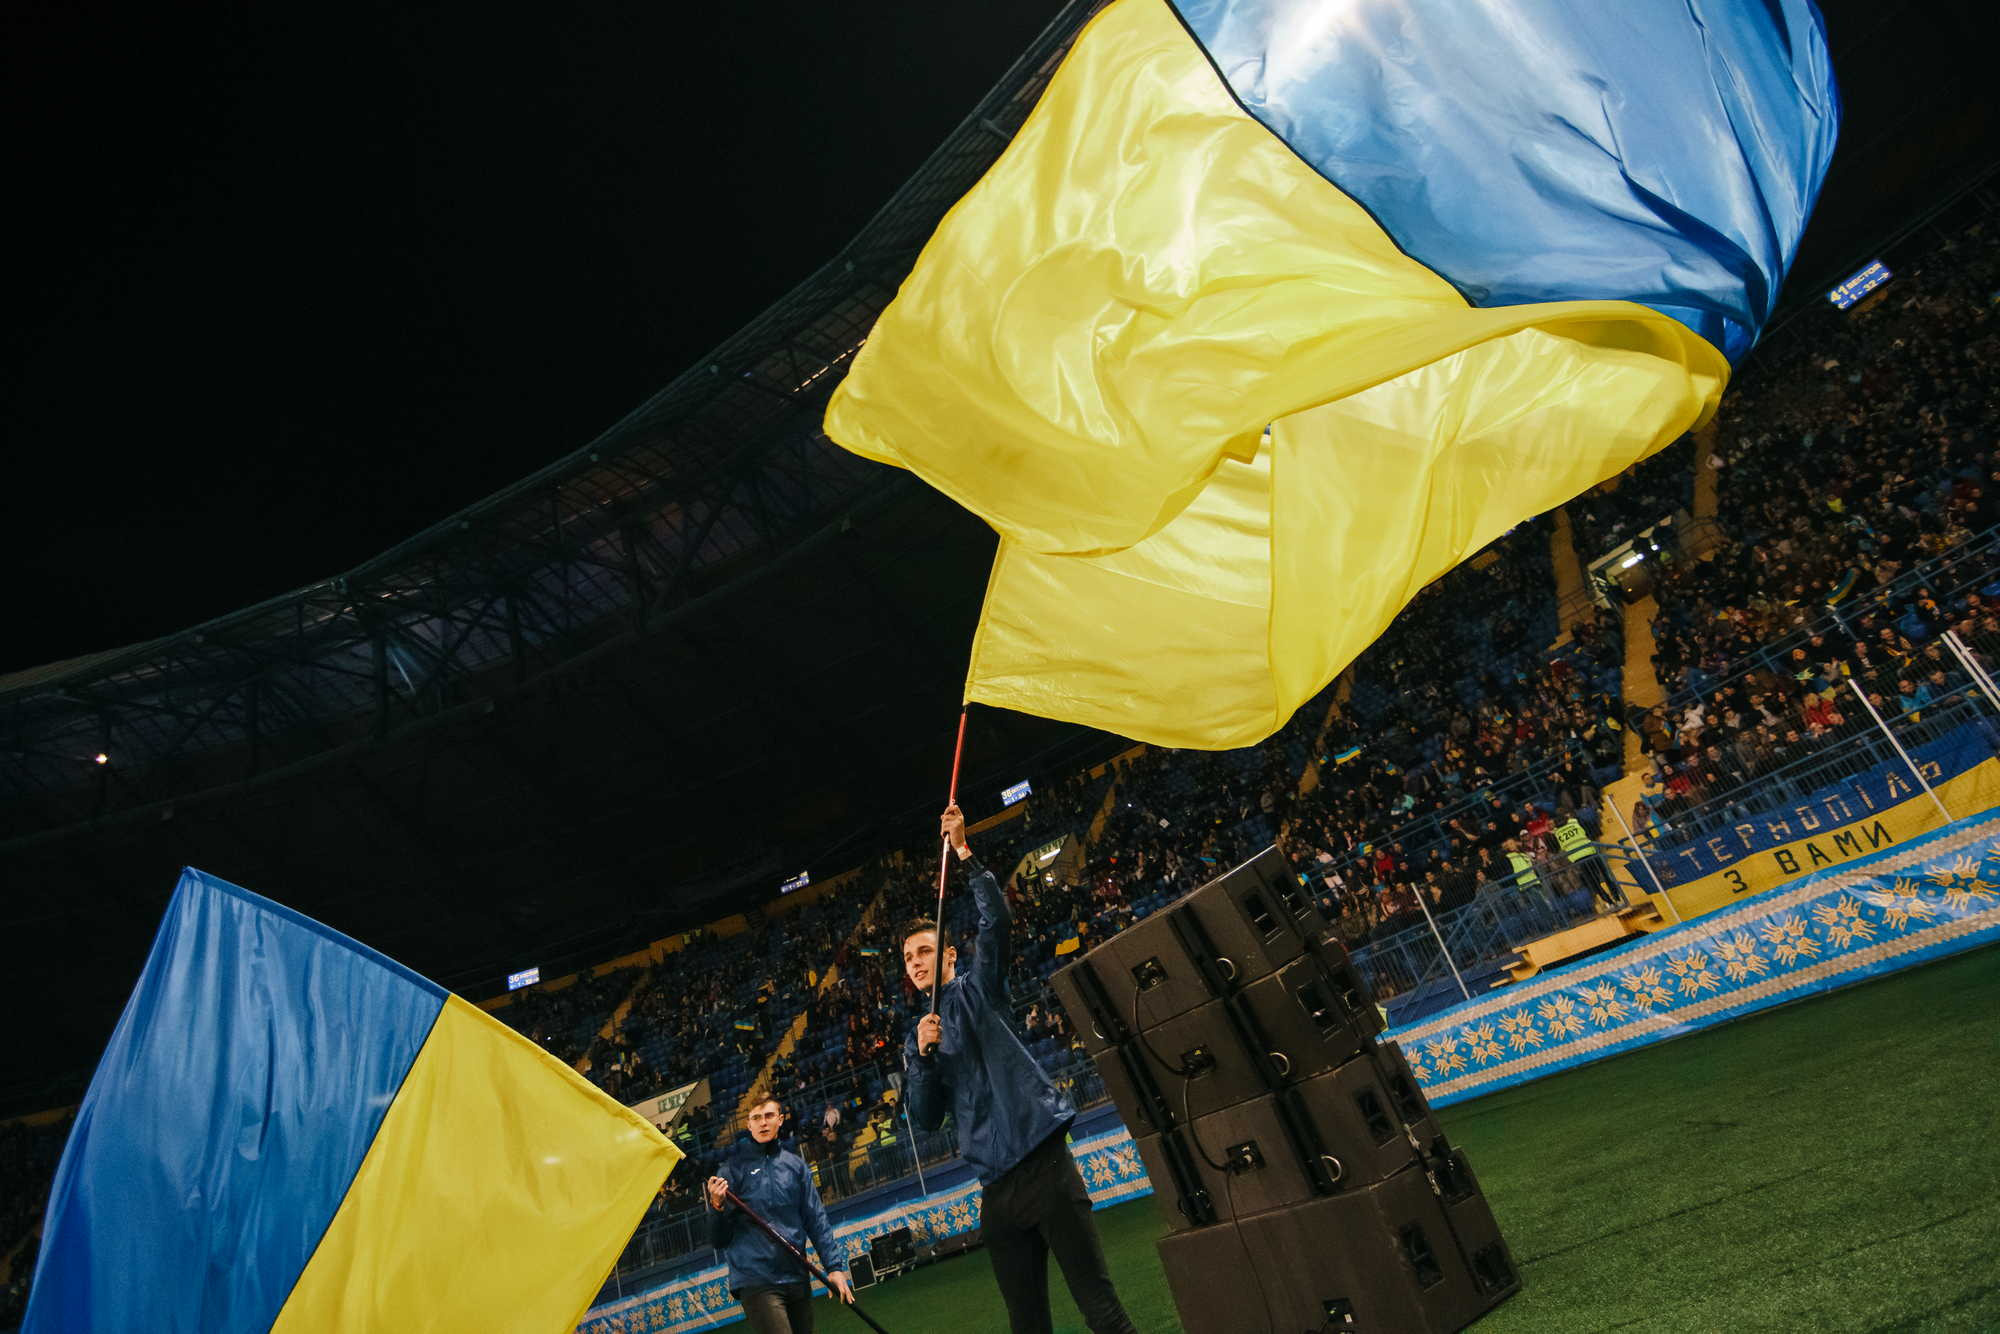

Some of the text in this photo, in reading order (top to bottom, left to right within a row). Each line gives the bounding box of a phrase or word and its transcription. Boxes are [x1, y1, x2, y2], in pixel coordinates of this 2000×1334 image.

[1830, 285, 1849, 302] 41
[1680, 758, 1944, 872] ТЕРНОПІЛЬ
[1774, 820, 1894, 876] ВАМИ
